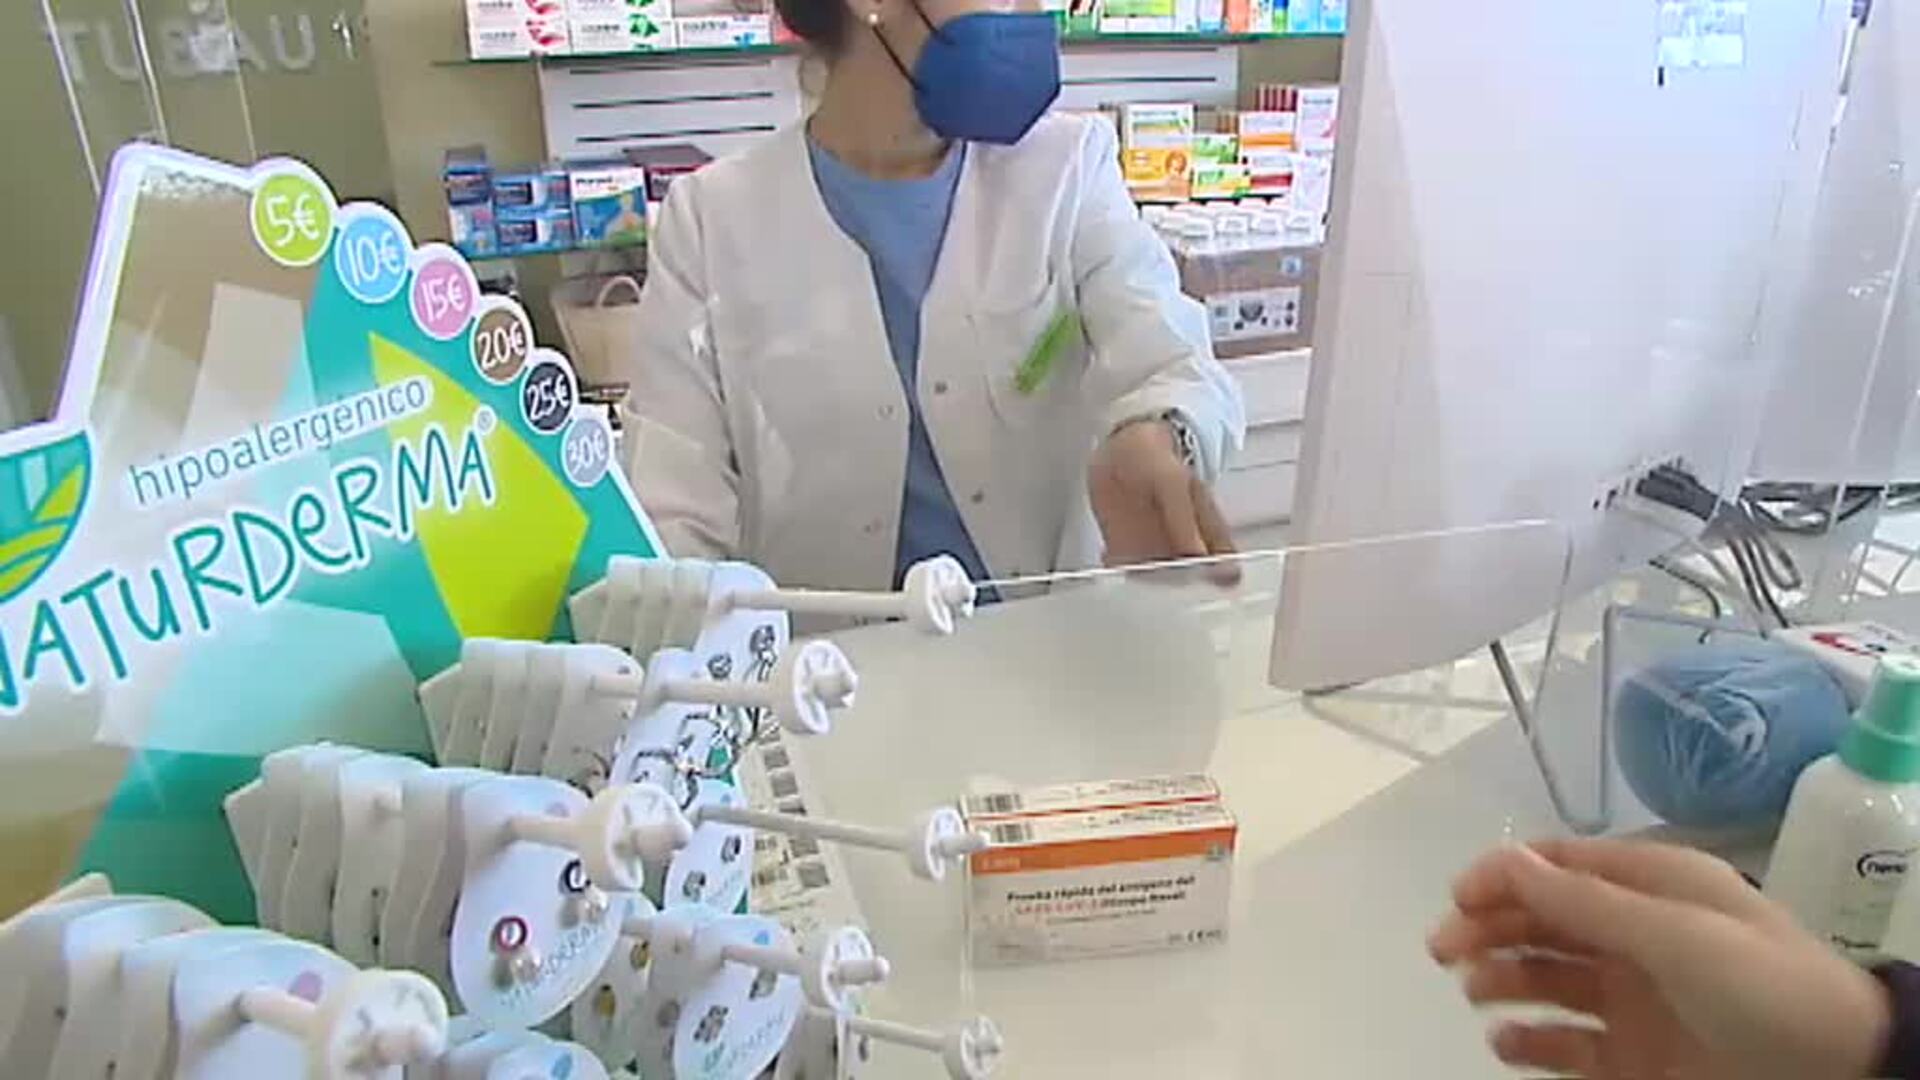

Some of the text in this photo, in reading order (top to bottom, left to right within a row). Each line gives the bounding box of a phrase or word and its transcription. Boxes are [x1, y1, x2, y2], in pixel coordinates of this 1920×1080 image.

[265, 191, 319, 247] 5€
[345, 230, 402, 287] 10€
[420, 273, 467, 323] 15€
[478, 320, 527, 371] 20€
[527, 373, 570, 421] 25€
[567, 428, 606, 475] 30€
